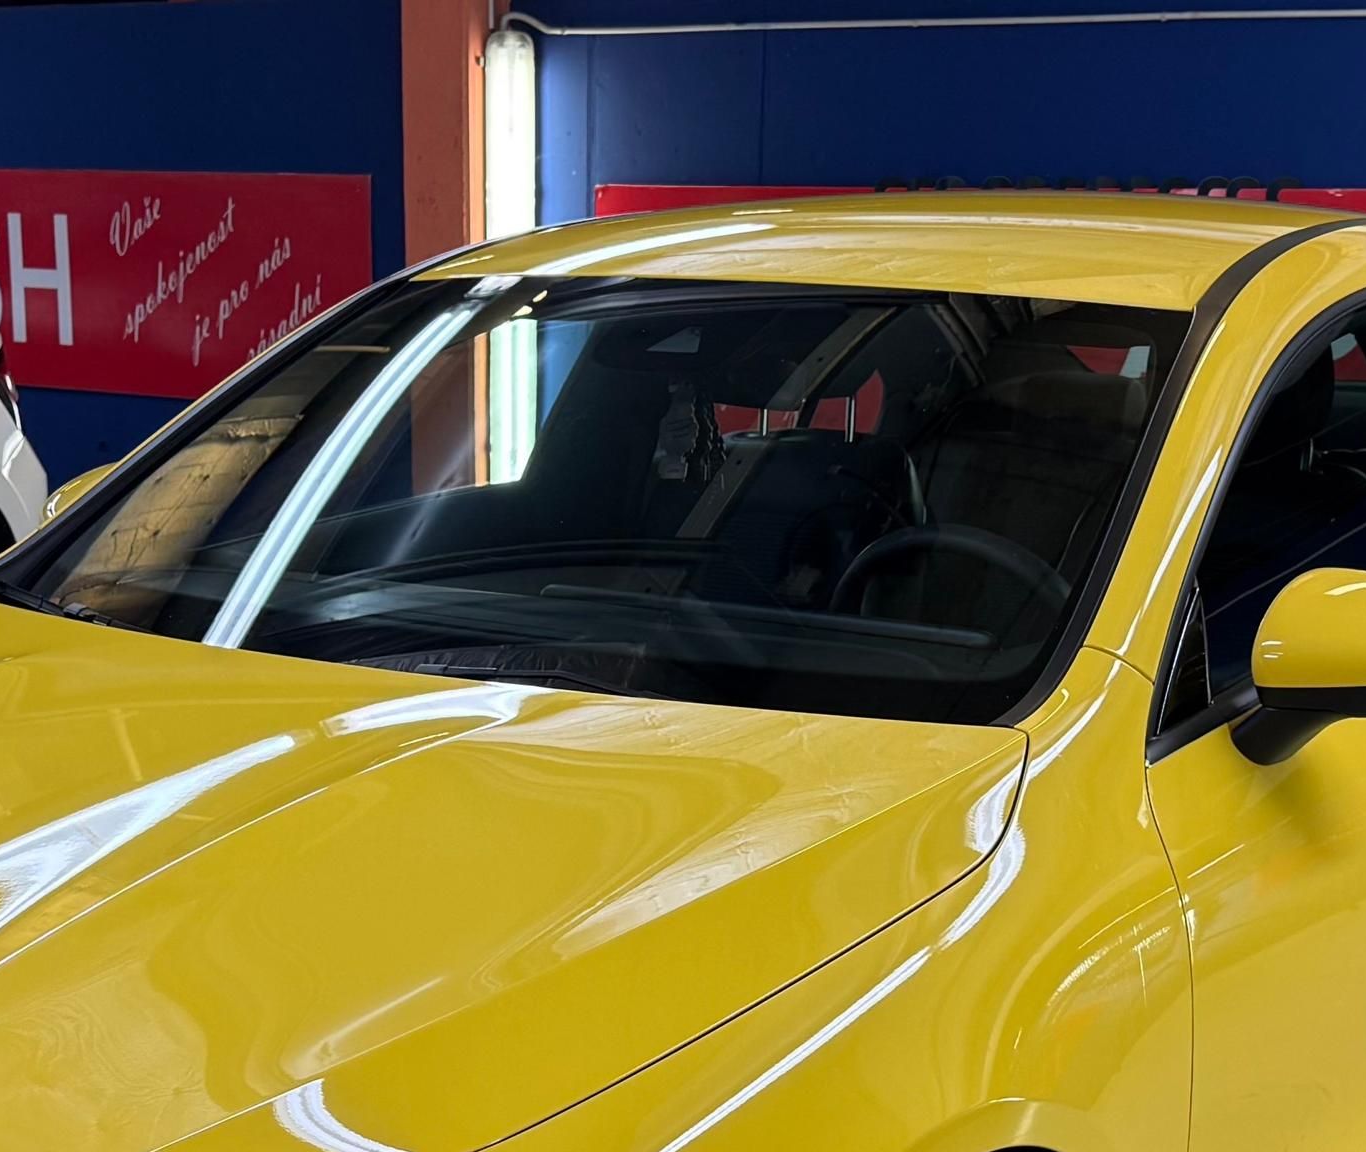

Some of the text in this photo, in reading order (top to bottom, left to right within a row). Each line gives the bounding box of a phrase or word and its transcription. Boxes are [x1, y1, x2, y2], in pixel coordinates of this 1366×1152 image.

[109, 196, 161, 257] Vaše
[123, 197, 236, 343] spokojenost
[192, 237, 291, 367] je pro nás
